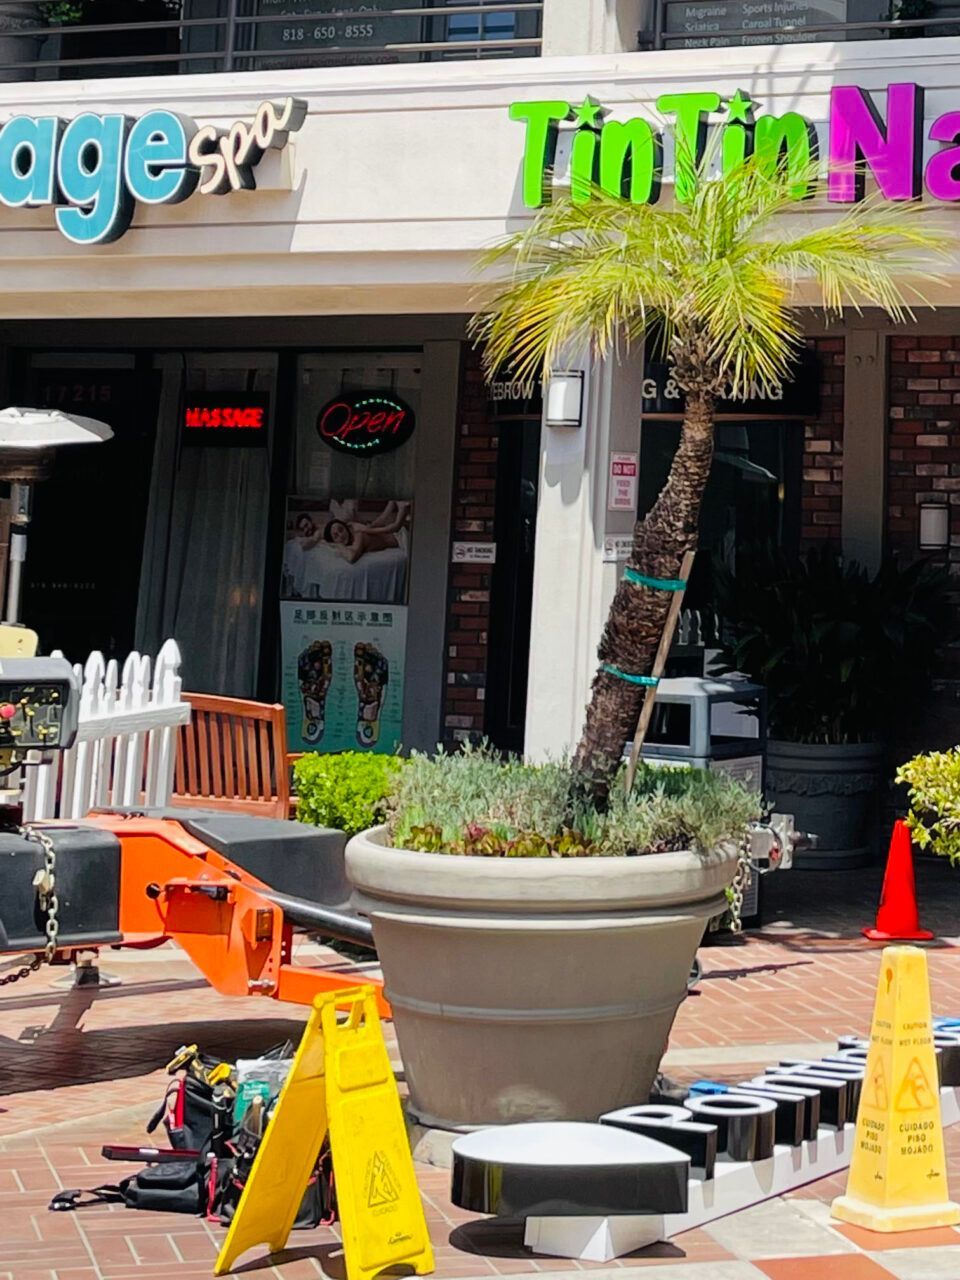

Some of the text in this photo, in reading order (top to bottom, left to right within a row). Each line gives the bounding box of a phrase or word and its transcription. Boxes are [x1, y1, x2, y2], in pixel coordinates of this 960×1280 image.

[742, 2, 773, 16] Sports
[774, 16, 806, 27] Tunnel
[282, 27, 304, 41] 818
[313, 25, 336, 40] 650
[345, 24, 374, 38] 8555
[0, 96, 303, 244] age spa
[185, 407, 264, 428] MASSAGE
[319, 403, 407, 439] Open
[899, 1121, 935, 1133] CUIDADO
[907, 1133, 927, 1143] PISO
[900, 1144, 934, 1155] MOJADO
